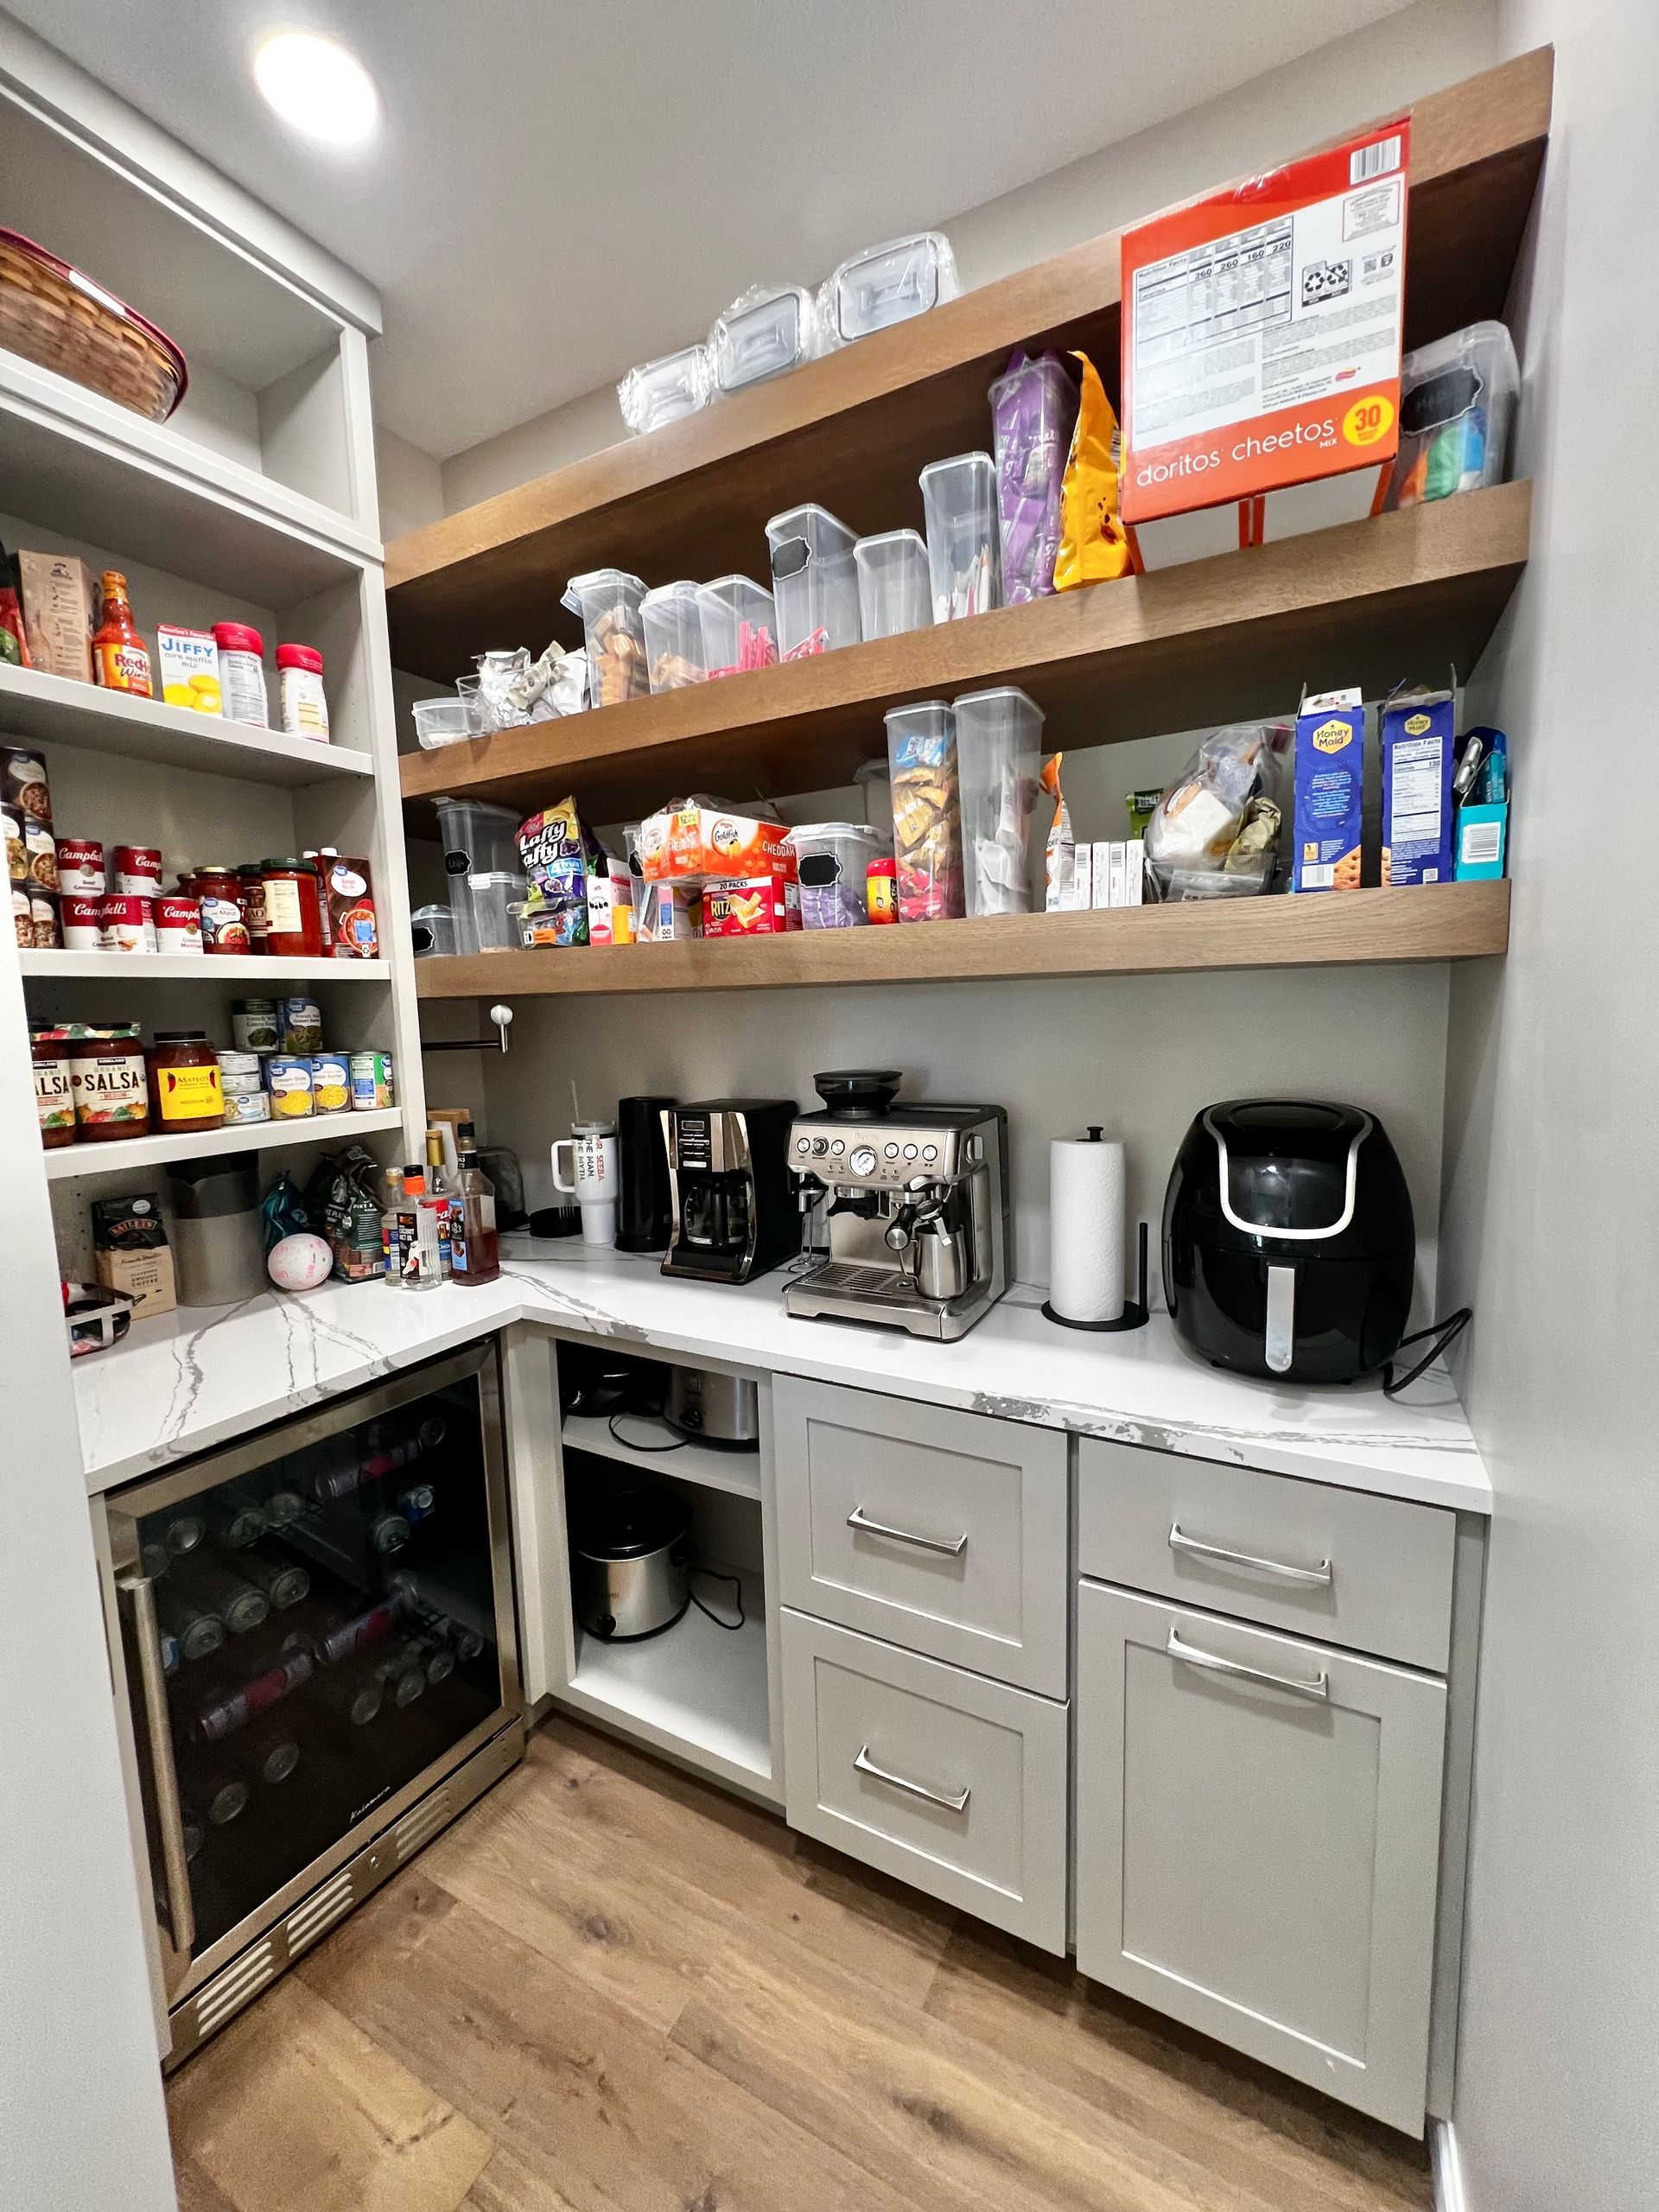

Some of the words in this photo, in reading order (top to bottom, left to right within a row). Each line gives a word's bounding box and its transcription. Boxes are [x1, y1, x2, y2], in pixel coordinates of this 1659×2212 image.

[1195, 268, 1213, 279] 260
[1220, 258, 1238, 270] 260
[1247, 250, 1264, 262] 160
[1273, 239, 1291, 252] 220
[1354, 404, 1382, 431] 30
[1319, 436, 1338, 448] MIX
[1136, 450, 1221, 486] doritos
[1231, 419, 1335, 461] cheetos
[161, 638, 214, 658] JIFFY
[1316, 728, 1349, 740] Honey
[1319, 736, 1344, 747] Maid
[519, 821, 566, 852] Laffy
[715, 829, 739, 842] Goldfish
[523, 842, 558, 869] affy
[710, 900, 730, 917] RITZ
[84, 1071, 140, 1091] SALSA
[111, 1218, 155, 1236] BAILEYS
[131, 1278, 159, 1287] COFFEE
